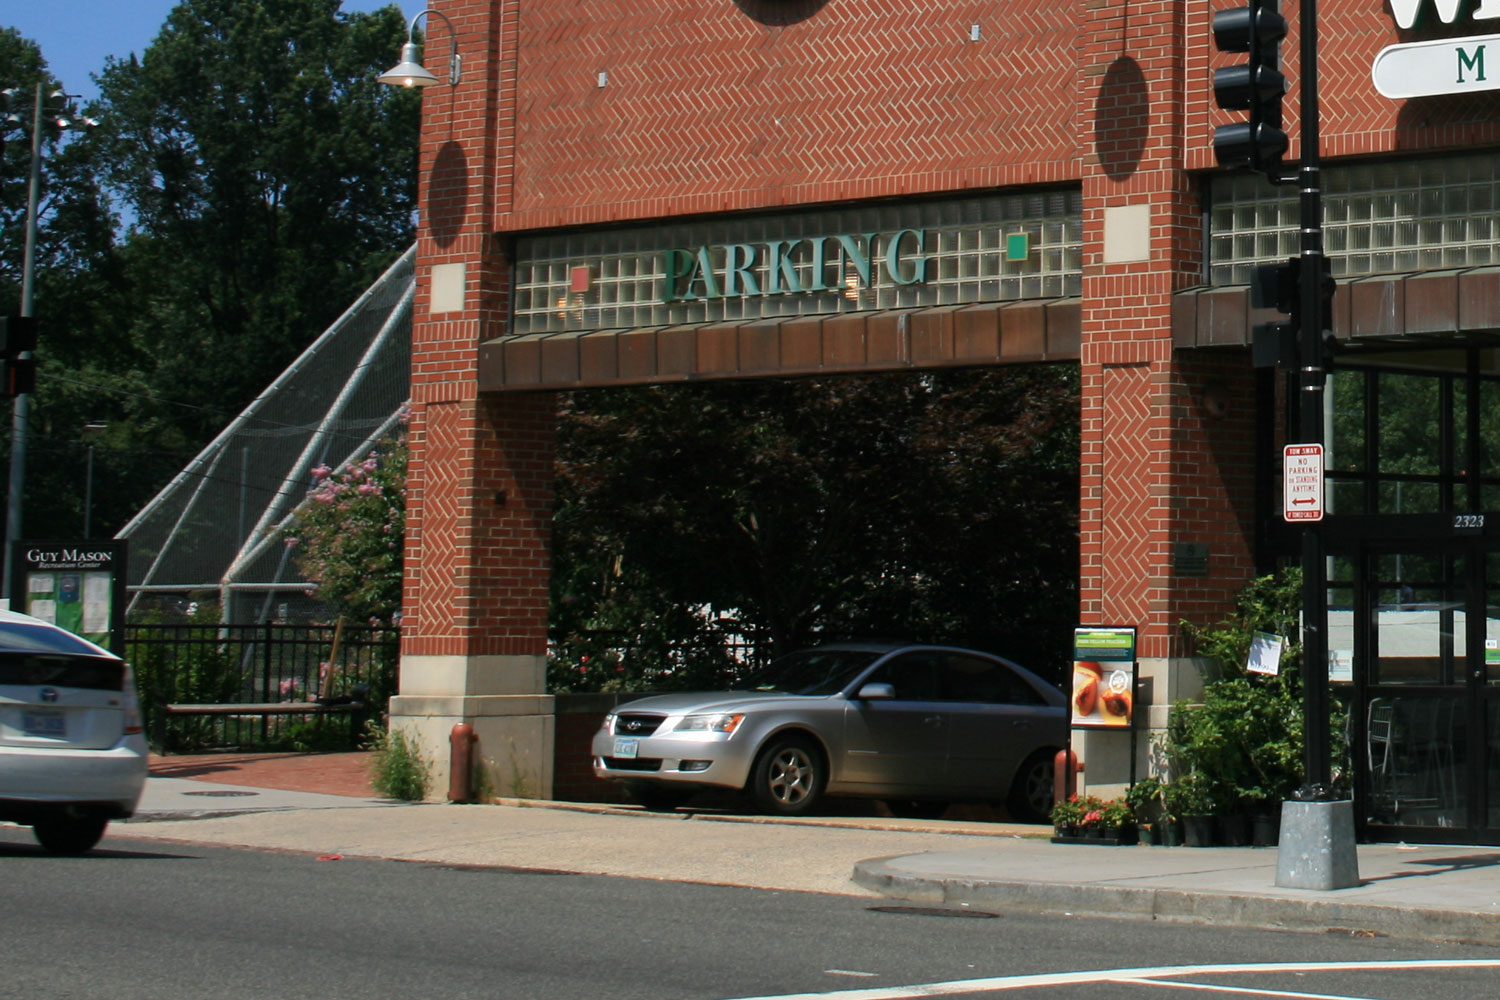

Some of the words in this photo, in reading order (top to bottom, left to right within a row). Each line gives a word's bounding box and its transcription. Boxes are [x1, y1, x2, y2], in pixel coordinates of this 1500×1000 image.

[664, 228, 927, 302] PARKING
[1289, 466, 1318, 474] PARKING
[1296, 475, 1318, 483] STANDING
[1454, 514, 1485, 528] 2323
[27, 549, 59, 562] GUY
[61, 549, 113, 562] MASON
